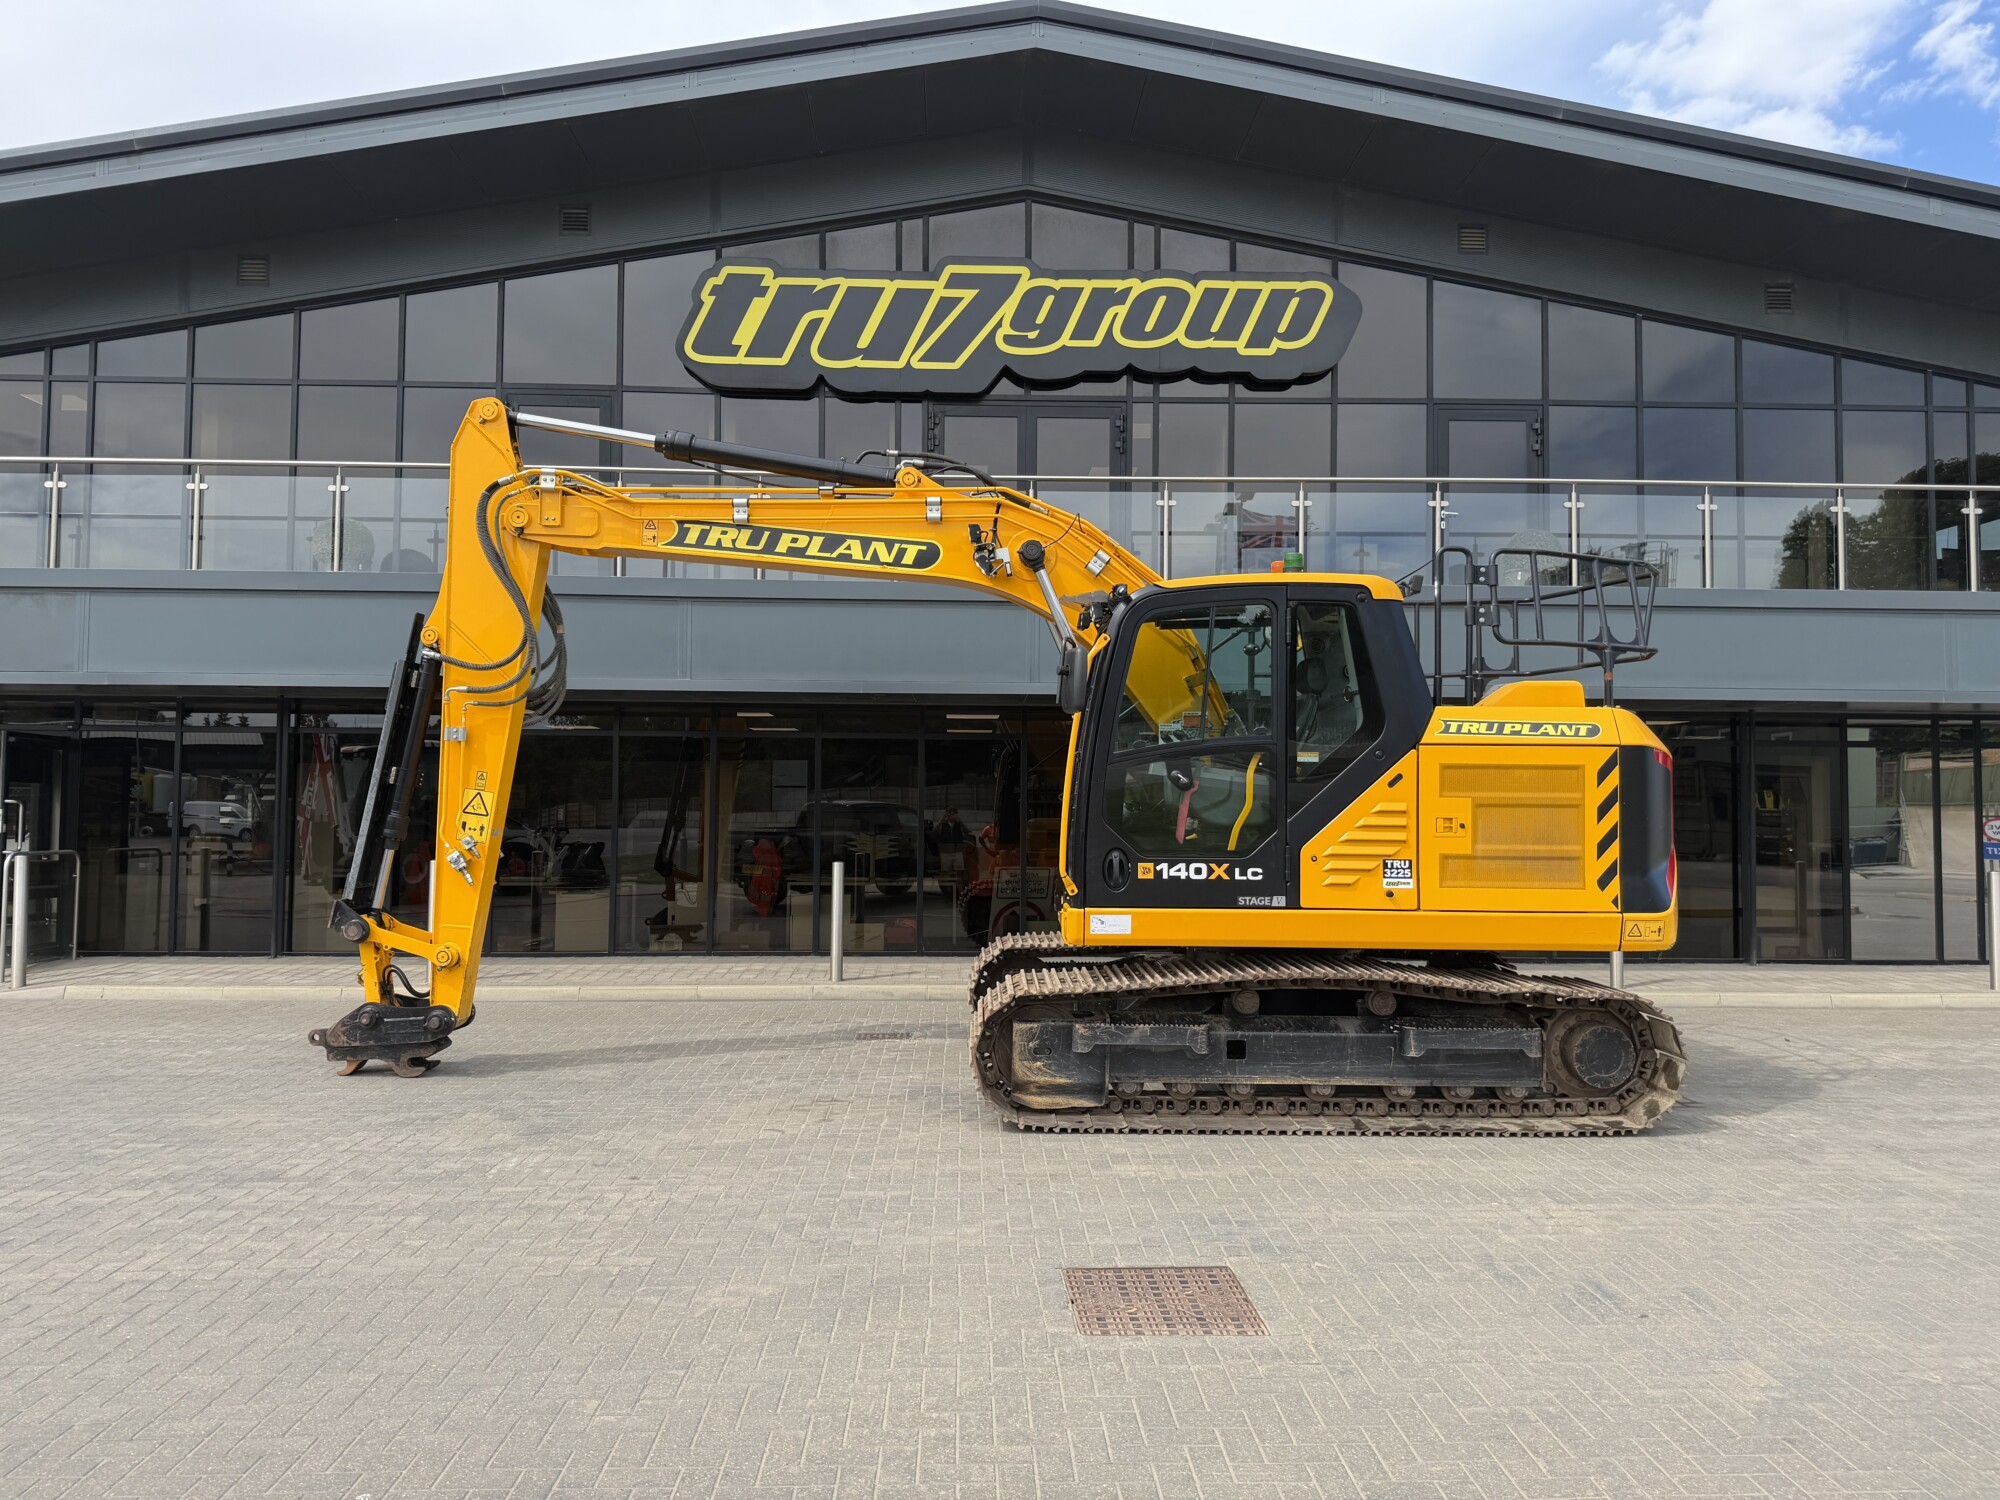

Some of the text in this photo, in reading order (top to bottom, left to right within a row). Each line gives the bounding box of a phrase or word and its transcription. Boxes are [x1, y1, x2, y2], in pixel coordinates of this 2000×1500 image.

[685, 265, 1334, 370] tru7group
[682, 523, 928, 565] TRU PLANT
[1446, 721, 1592, 736] TRU PLANT
[1385, 860, 1410, 869] TRU
[1234, 867, 1263, 881] LC
[1384, 868, 1412, 878] 3225
[1238, 896, 1271, 906] STAGE
